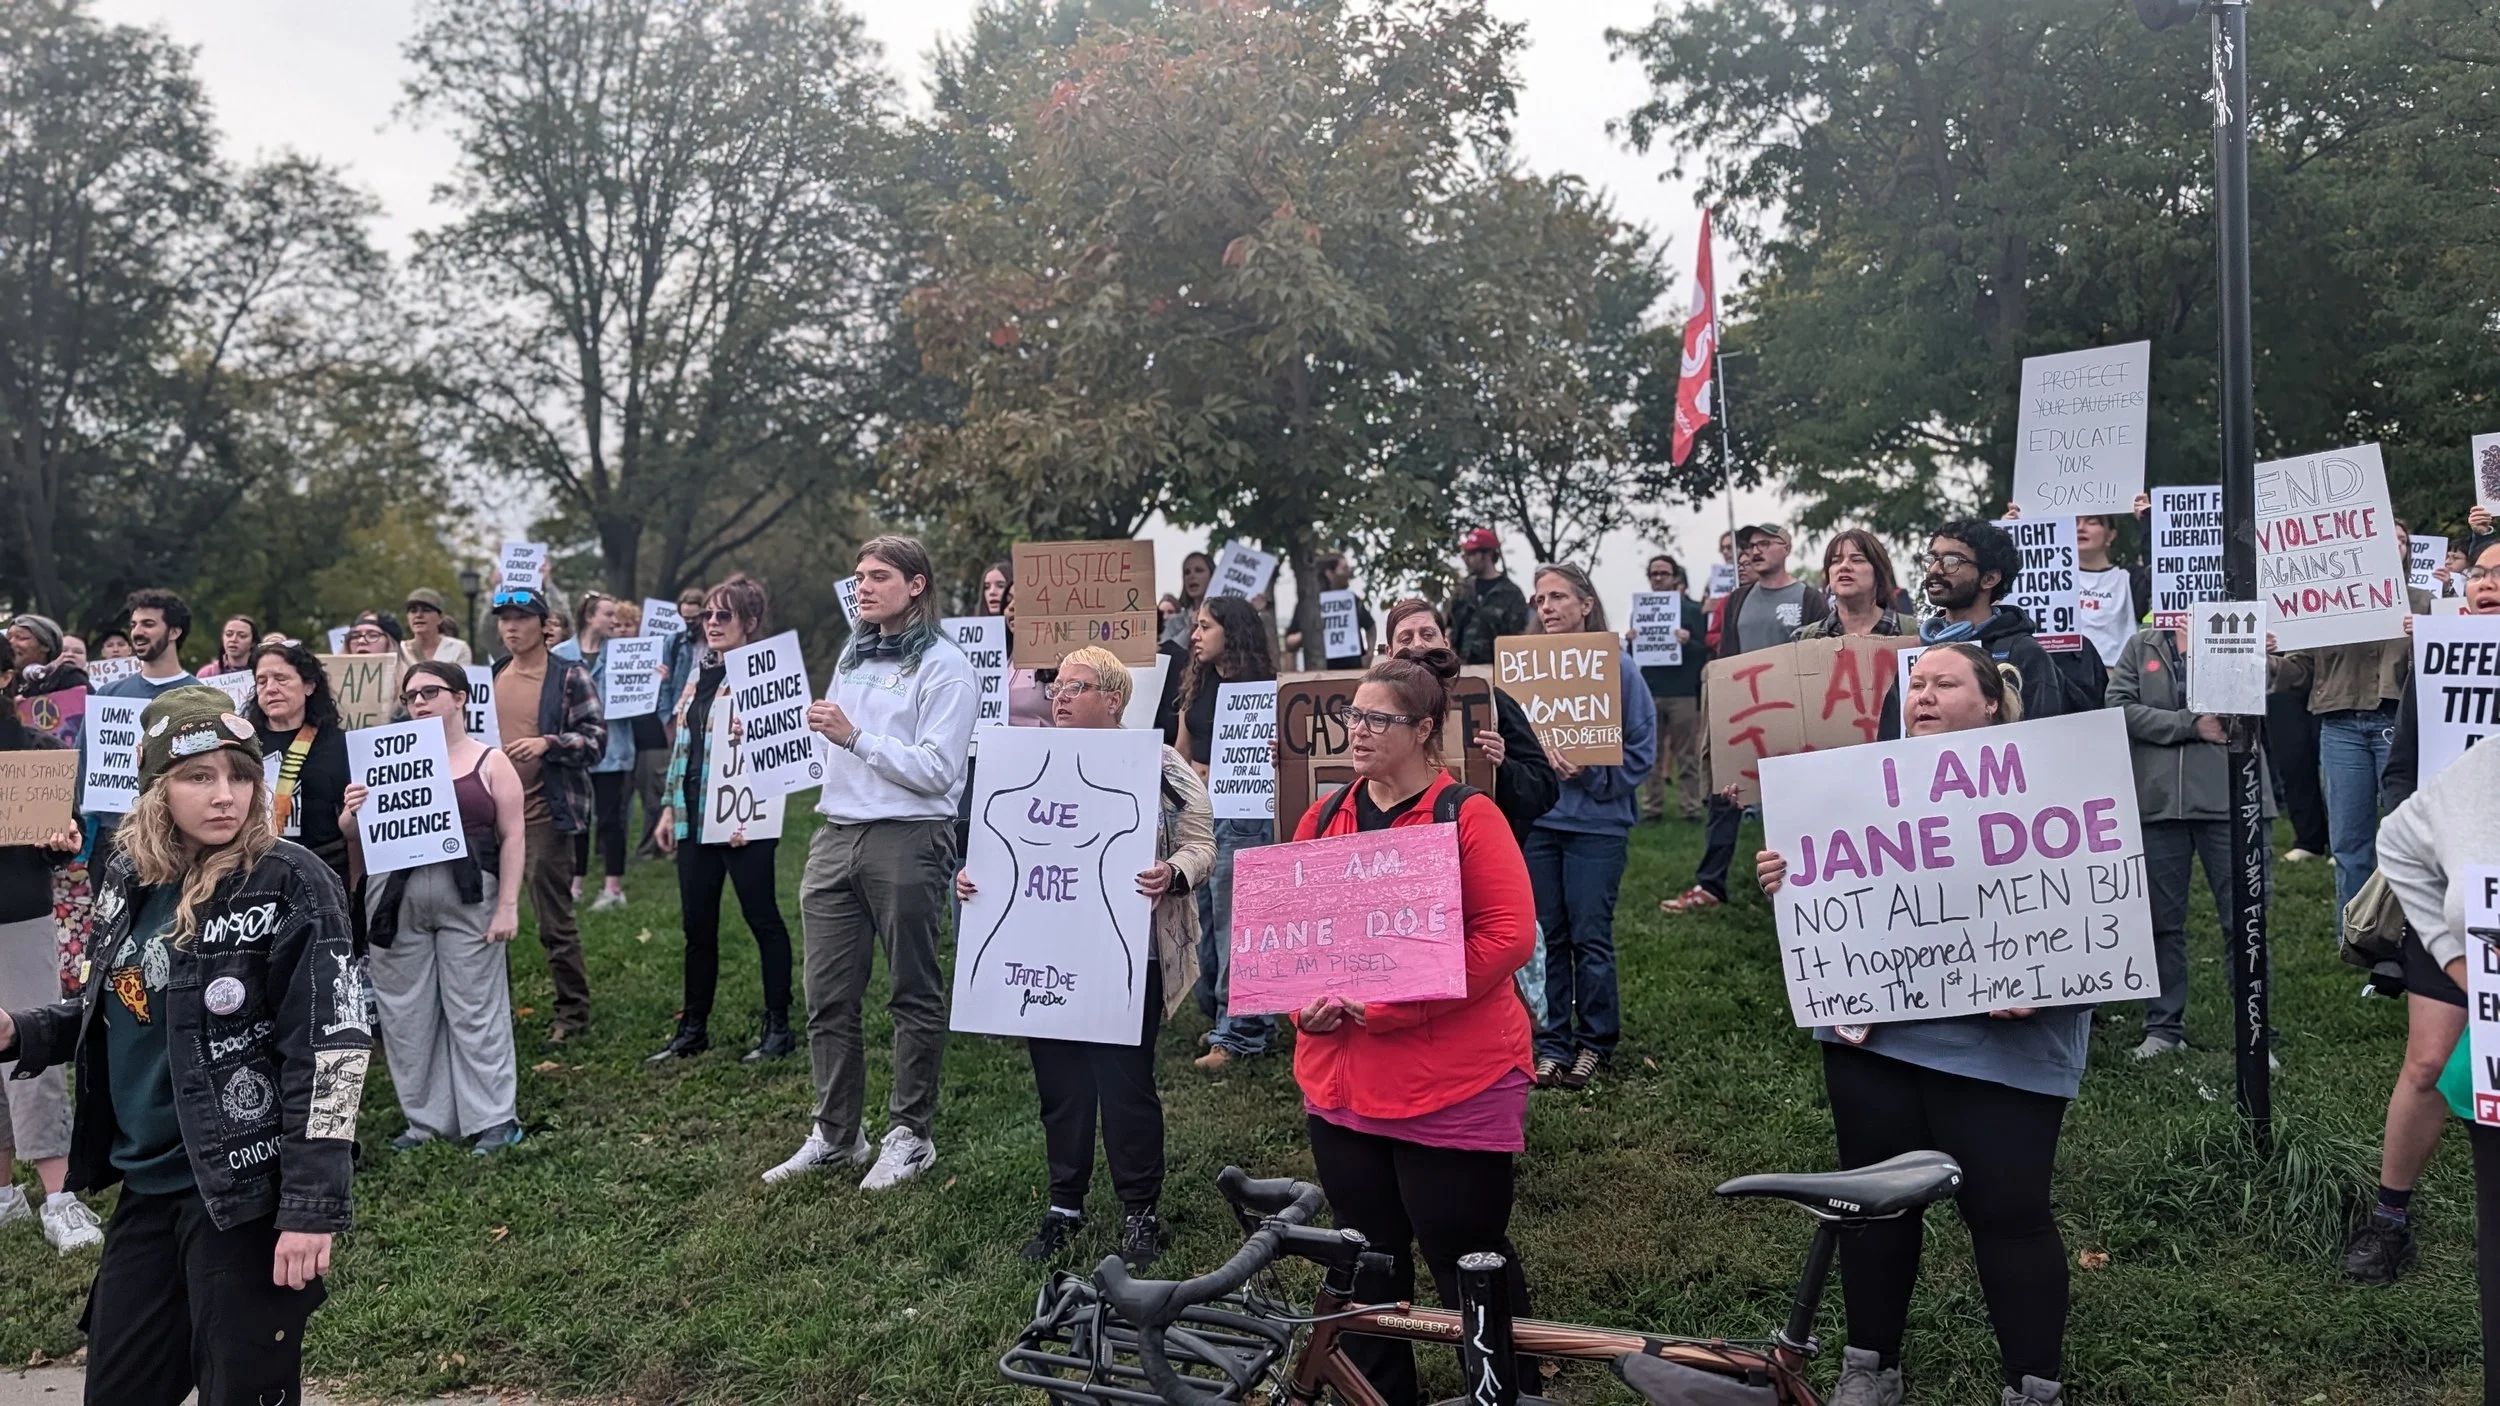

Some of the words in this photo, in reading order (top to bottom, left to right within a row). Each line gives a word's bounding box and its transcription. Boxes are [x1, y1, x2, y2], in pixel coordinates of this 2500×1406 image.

[2041, 361, 2131, 394] PROTECT
[2034, 398, 2068, 419] YOUR
[2071, 391, 2144, 415] DAUGHTERS
[2029, 425, 2133, 452] EDUCATE
[2056, 454, 2093, 477] YOUR
[2037, 481, 2118, 511] SONS!!!
[2255, 457, 2365, 516] END
[2162, 493, 2207, 512] FIGHT
[2256, 507, 2378, 555] VIOLENCE
[505, 560, 537, 570] GENDER
[512, 548, 534, 557] STOP
[2157, 557, 2184, 573] END
[507, 572, 532, 582] BASED
[1024, 551, 1133, 589] JUSTICE
[1224, 567, 1256, 588] STAND
[2260, 547, 2363, 589] AGAINST
[1036, 586, 1050, 617] 4
[1065, 586, 1105, 613] ALL
[1639, 596, 1671, 606] JUSTICE
[2017, 595, 2050, 607] ON
[2272, 577, 2402, 619] WOMEN!
[648, 618, 679, 631] GENDER
[655, 607, 677, 617] STOP
[1636, 613, 1656, 623] JANE
[2053, 607, 2075, 633] 9!
[959, 626, 983, 644] END
[1030, 621, 1080, 647] JANE
[1639, 626, 1670, 636] JUSTICE
[616, 642, 652, 653] JUSTICE
[611, 660, 635, 670] JANE
[748, 649, 776, 678] END
[1500, 647, 1609, 684] BELIEVE
[337, 661, 383, 704] AM
[614, 674, 652, 685] JUSTICE
[736, 673, 803, 712] VIOLENCE
[1227, 693, 1276, 711] JUSTICE
[102, 707, 134, 724] UMN:
[746, 705, 803, 743] AGAINST
[1243, 712, 1258, 722] FOR
[100, 730, 135, 746] STAND
[1219, 724, 1251, 740] JANE
[1537, 725, 1623, 749] #DOBETTER
[374, 733, 417, 758] STOP
[751, 736, 813, 773] WOMEN!
[1222, 747, 1271, 764] JUSTICE
[31, 763, 76, 780] STANDS
[103, 754, 131, 769] WITH
[366, 758, 434, 788] GENDER
[1232, 765, 1247, 776] FOR
[1248, 765, 1261, 776] ALL
[1882, 757, 1900, 808] I
[1930, 742, 2027, 803] AM
[26, 784, 74, 802] STANDS
[378, 787, 433, 814] BASED
[716, 785, 767, 824] DOE
[2240, 758, 2260, 844] WEAK
[1027, 797, 1079, 829] WE
[369, 811, 452, 844] VIOLENCE
[1789, 815, 1955, 887] JANE
[1978, 797, 2123, 867] DOE
[1294, 860, 1304, 889] I
[1344, 847, 1402, 881] AM
[1025, 864, 1079, 902] ARE
[1794, 886, 1874, 936] NOT
[1887, 882, 1970, 931] ALL
[1977, 868, 2070, 919] MEN
[2087, 853, 2144, 904] BUT
[203, 911, 243, 943] DAYS
[1236, 917, 1335, 954] JANE
[1365, 902, 1446, 939] DOE
[2244, 905, 2263, 973] FUCK
[1790, 946, 1831, 981] It
[1842, 927, 1976, 983] happened
[1984, 921, 2019, 962] to
[2025, 927, 2073, 958] me
[2084, 914, 2120, 954] 13
[1271, 961, 1288, 978] I
[1295, 956, 1318, 975] AM
[1326, 952, 1397, 974] PISSED
[1805, 987, 1879, 1018] times.
[1881, 980, 1930, 1013] The
[1941, 967, 1963, 1009] 1st
[1967, 972, 2024, 1005] time
[2026, 964, 2052, 1001] I
[2062, 969, 2114, 998] was
[2123, 955, 2151, 991] 6.
[1828, 1198, 1861, 1212] WTB
[1377, 1315, 1450, 1334] CONQUEST
